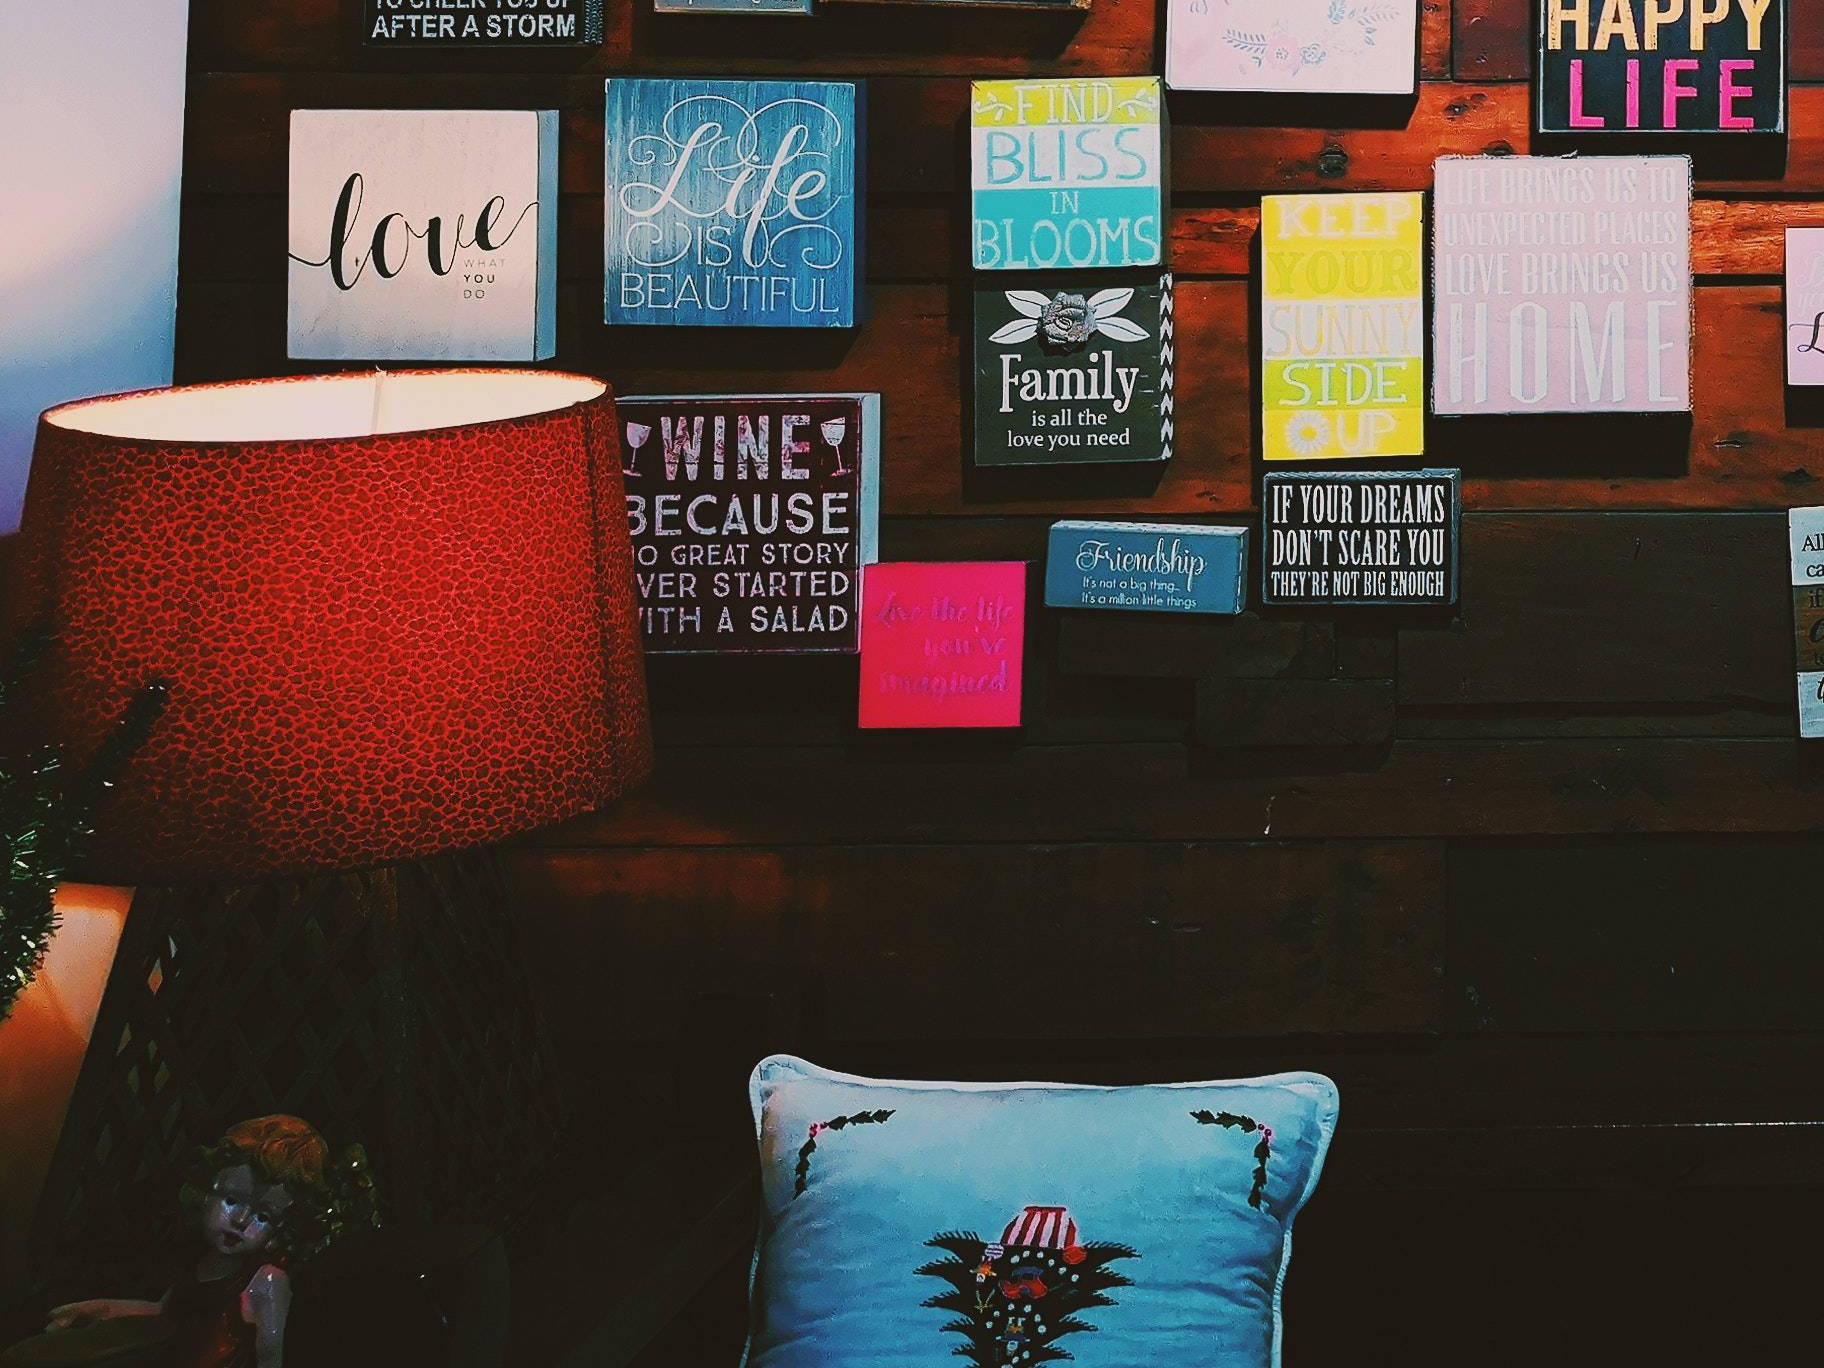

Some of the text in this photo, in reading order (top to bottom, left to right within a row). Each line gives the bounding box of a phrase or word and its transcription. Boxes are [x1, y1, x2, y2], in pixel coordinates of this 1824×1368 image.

[1570, 59, 1754, 127] LIFE
[986, 128, 1147, 185] BLISS
[1000, 352, 1138, 414] Family
[1008, 430, 1130, 450] love you need
[1032, 409, 1107, 426] is all the
[661, 415, 810, 481] WINE
[1272, 485, 1445, 523] IF YOUR DREAMS
